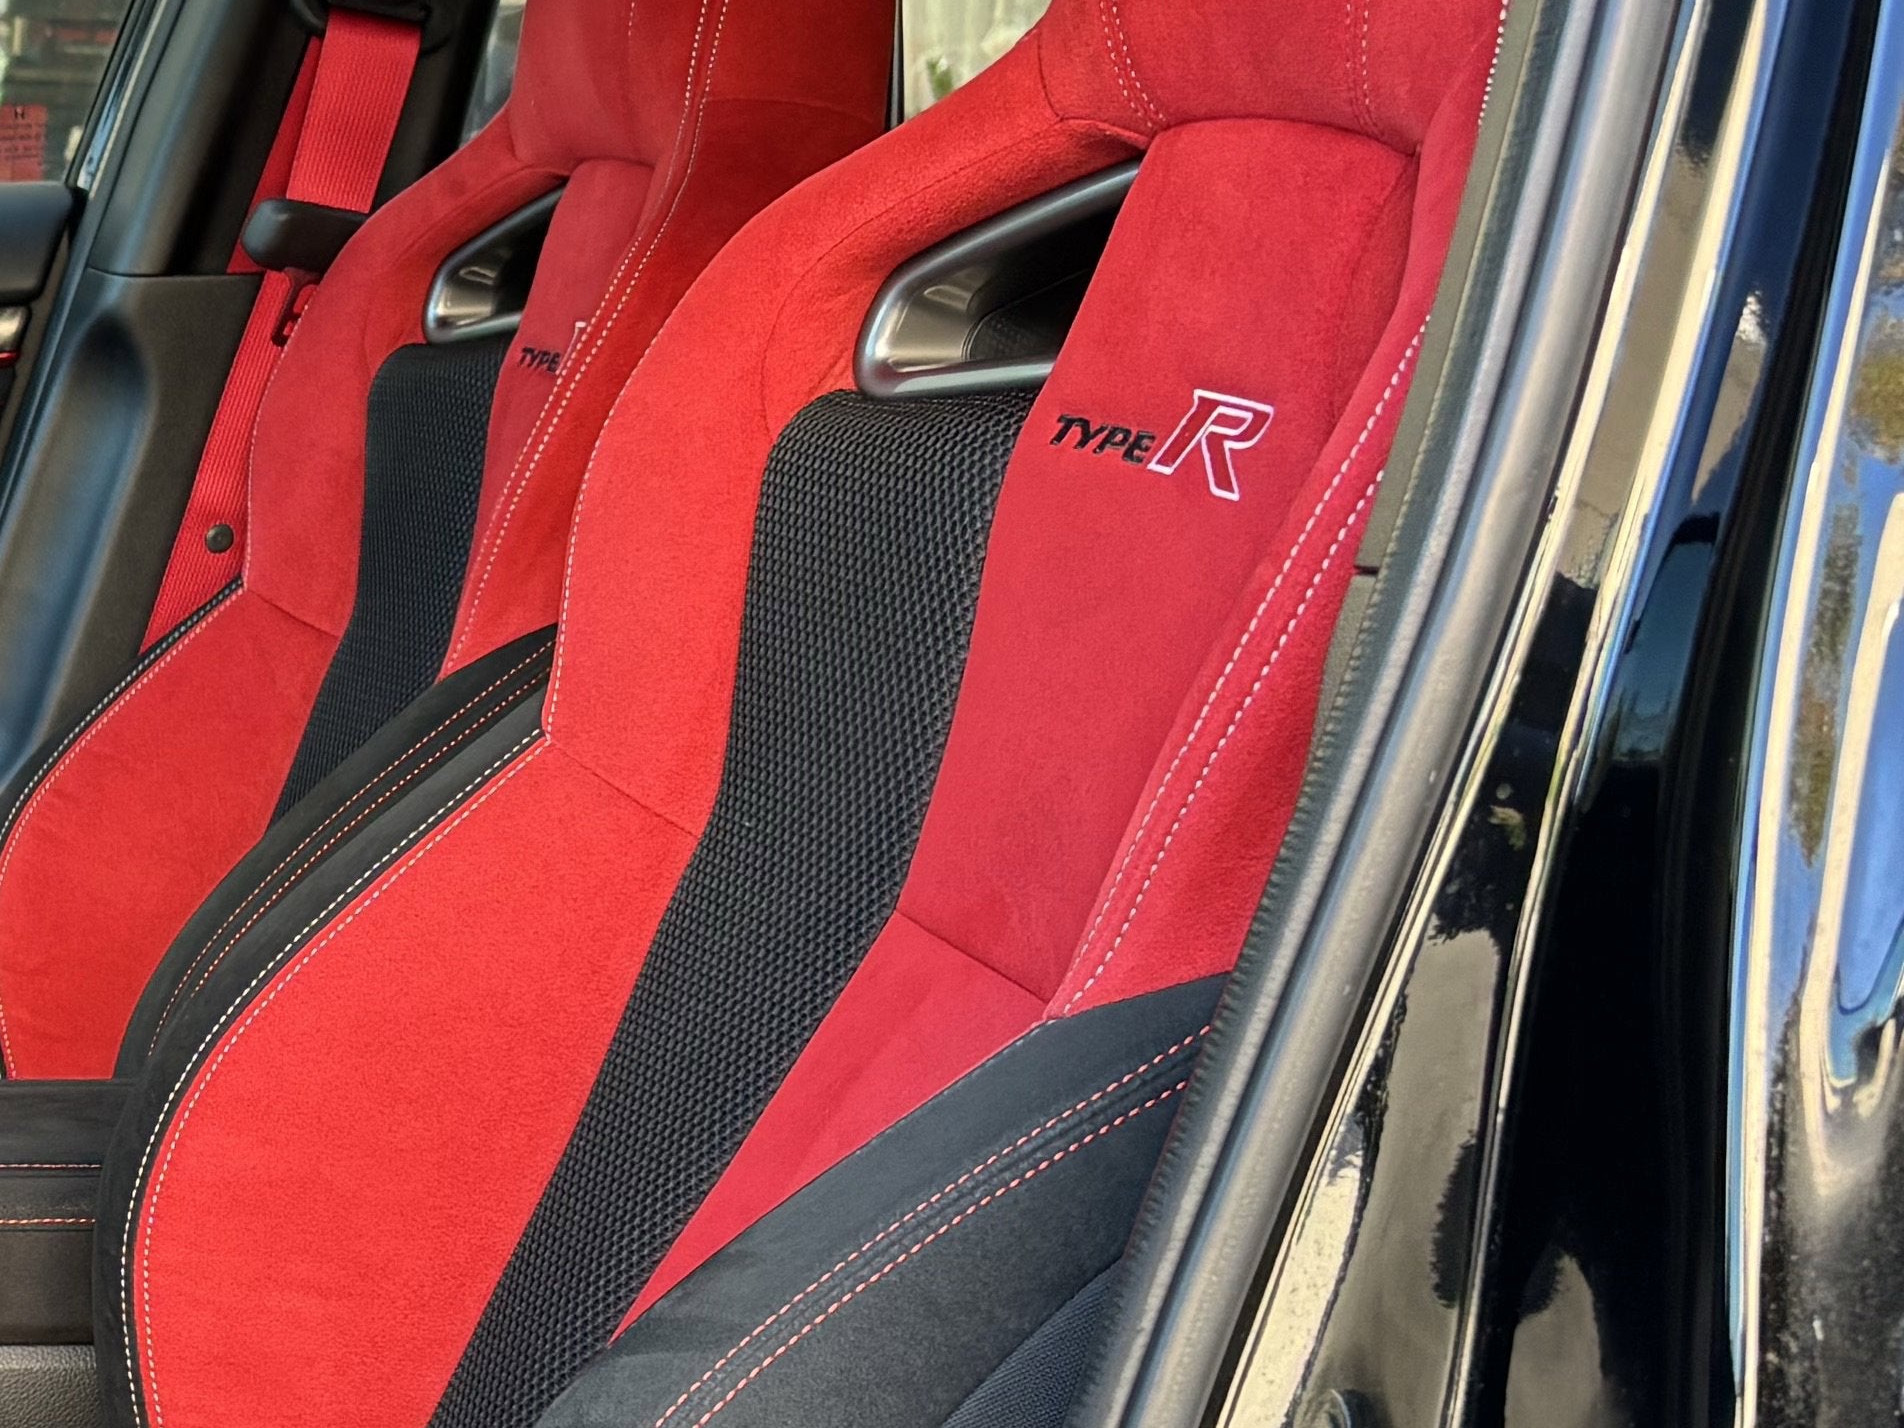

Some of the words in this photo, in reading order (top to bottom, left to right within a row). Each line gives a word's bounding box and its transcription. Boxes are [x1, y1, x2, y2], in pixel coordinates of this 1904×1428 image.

[517, 347, 562, 375] TYPE
[1049, 414, 1156, 465] TYPE
[1147, 389, 1274, 501] R
